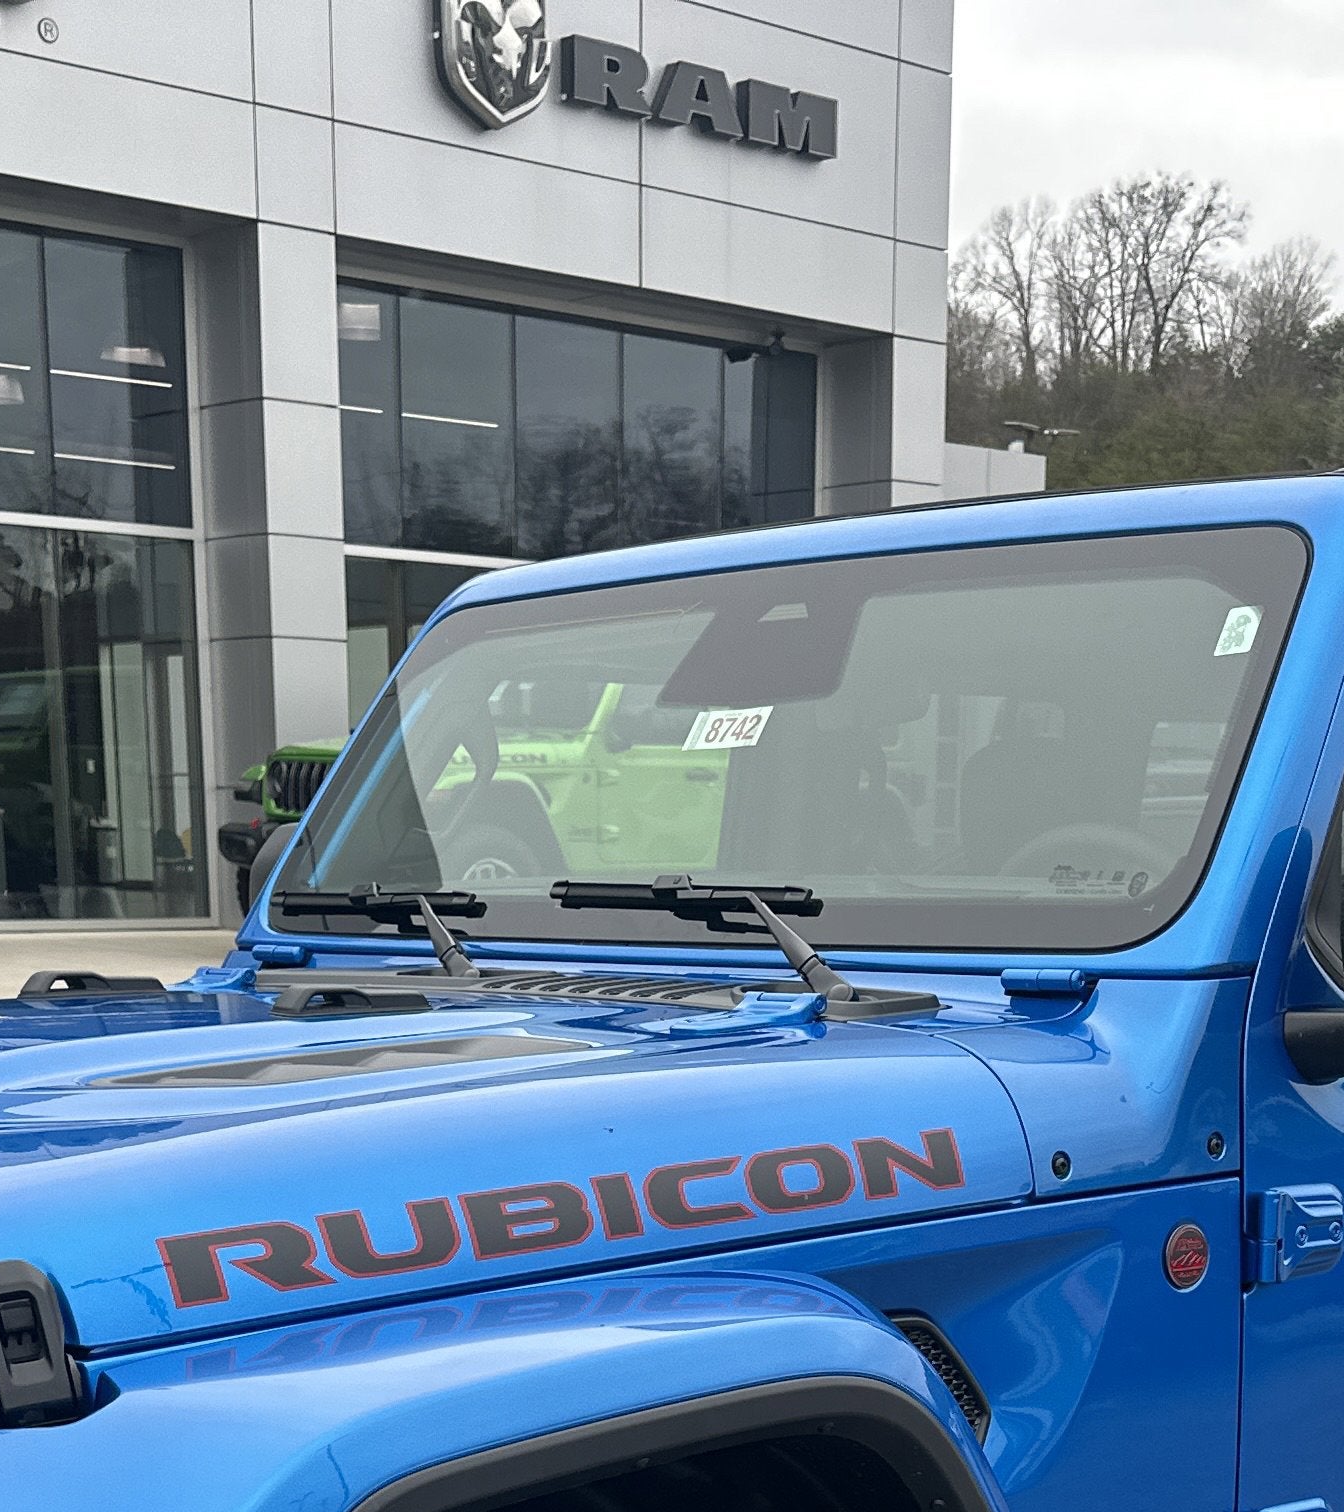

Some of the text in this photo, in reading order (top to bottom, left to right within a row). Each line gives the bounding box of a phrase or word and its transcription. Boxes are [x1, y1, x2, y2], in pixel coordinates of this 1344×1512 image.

[560, 34, 839, 159] RAM
[704, 714, 762, 743] 8742
[155, 1127, 967, 1309] RUBICON
